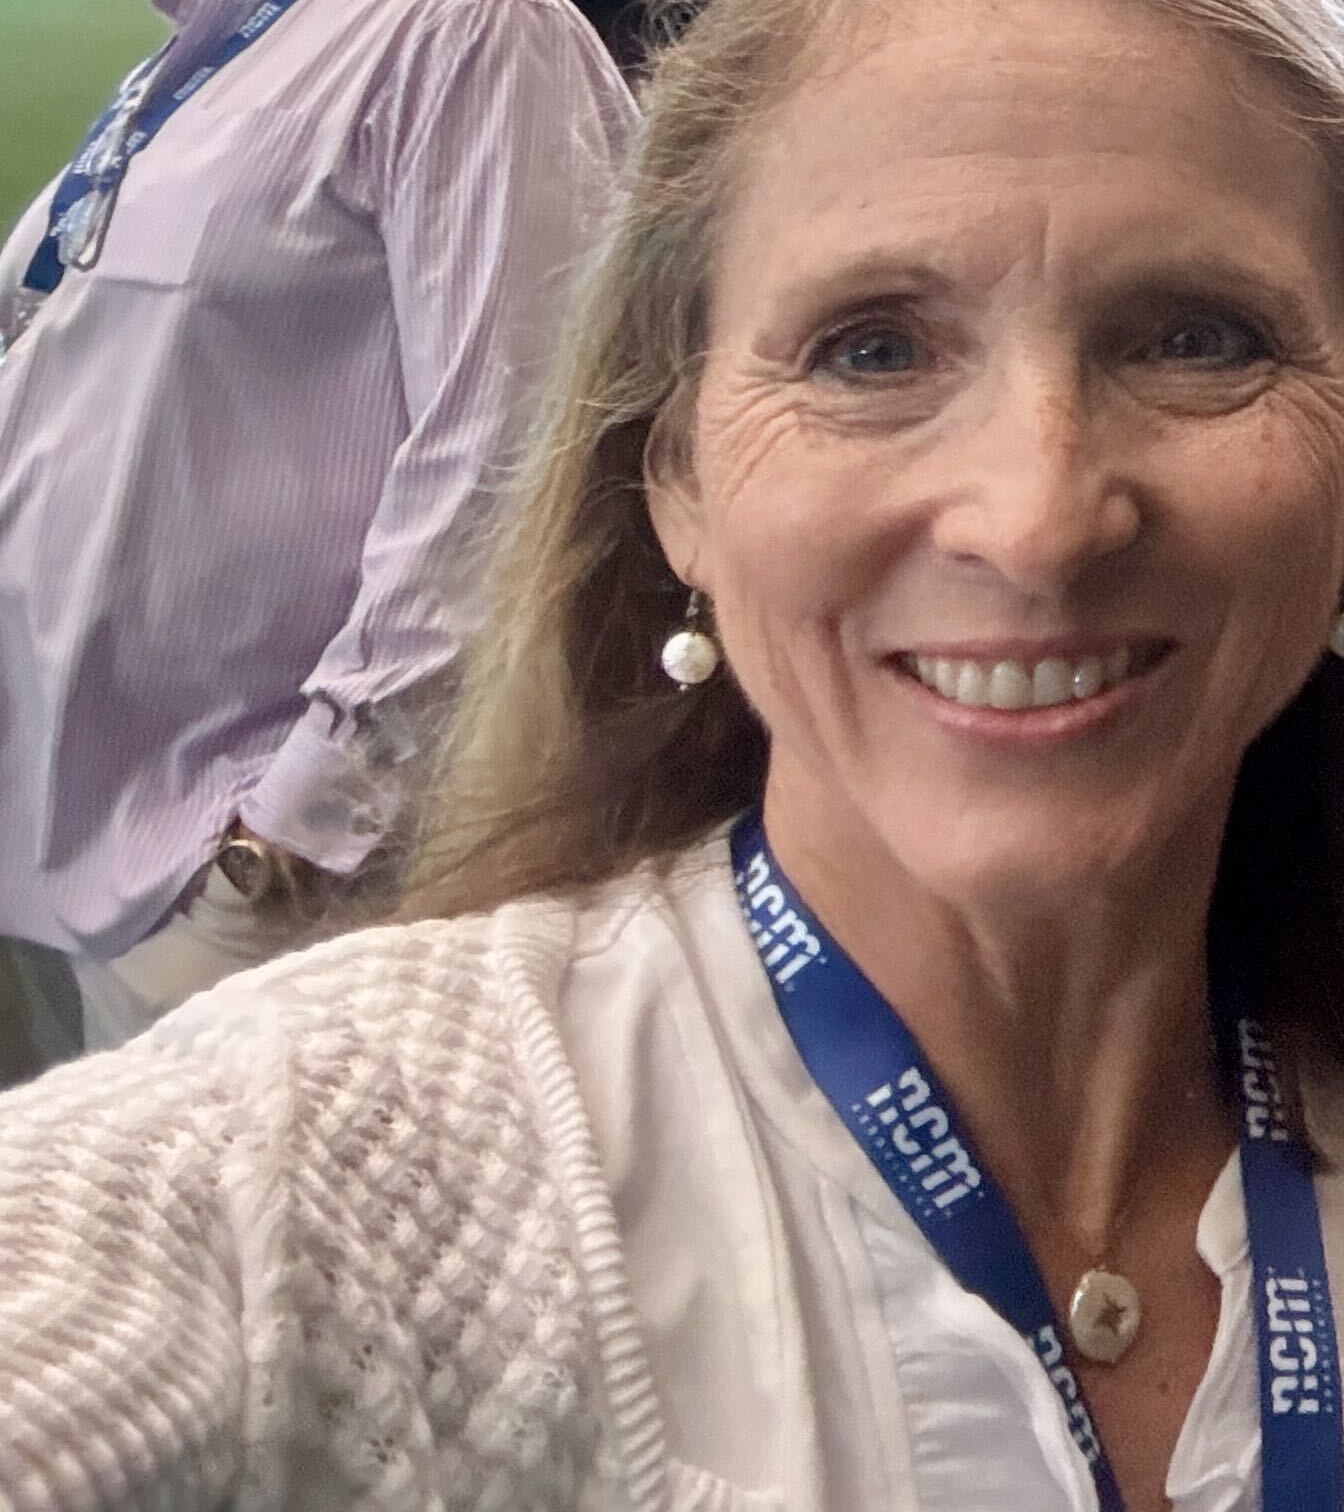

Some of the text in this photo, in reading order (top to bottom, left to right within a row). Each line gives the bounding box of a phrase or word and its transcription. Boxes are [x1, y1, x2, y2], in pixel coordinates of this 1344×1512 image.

[736, 851, 821, 985] ncm
[865, 1066, 983, 1210] ncm
[1266, 1276, 1321, 1415] ncm
